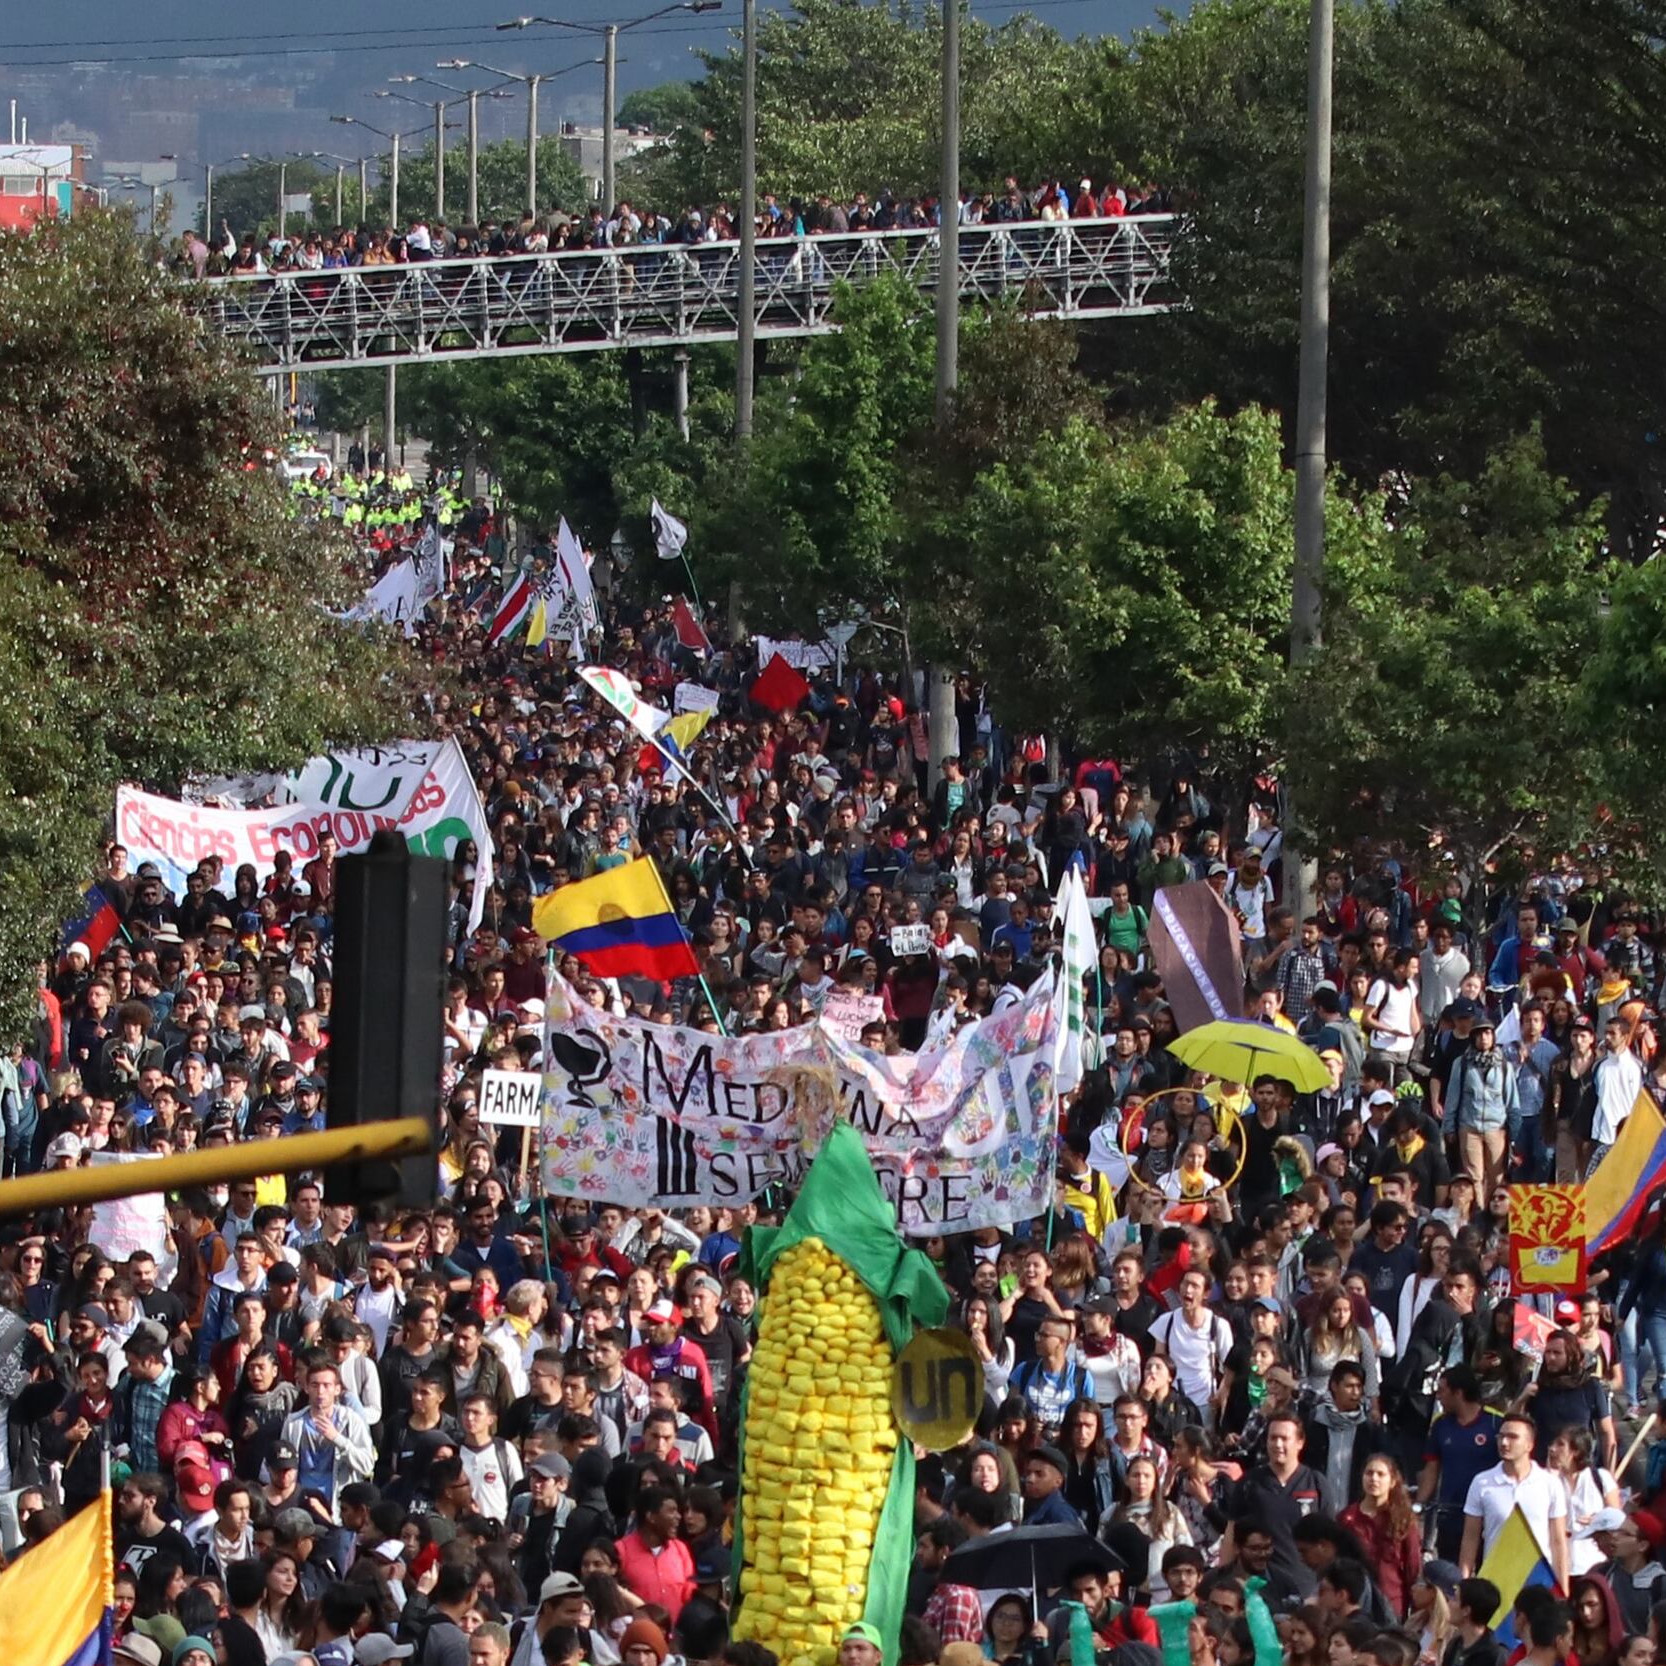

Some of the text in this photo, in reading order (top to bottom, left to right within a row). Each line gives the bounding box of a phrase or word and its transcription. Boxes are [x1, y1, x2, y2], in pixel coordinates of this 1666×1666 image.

[120, 797, 237, 866] Ciencias
[639, 1036, 929, 1138] MEDINA
[711, 1150, 974, 1223] SEMTRE
